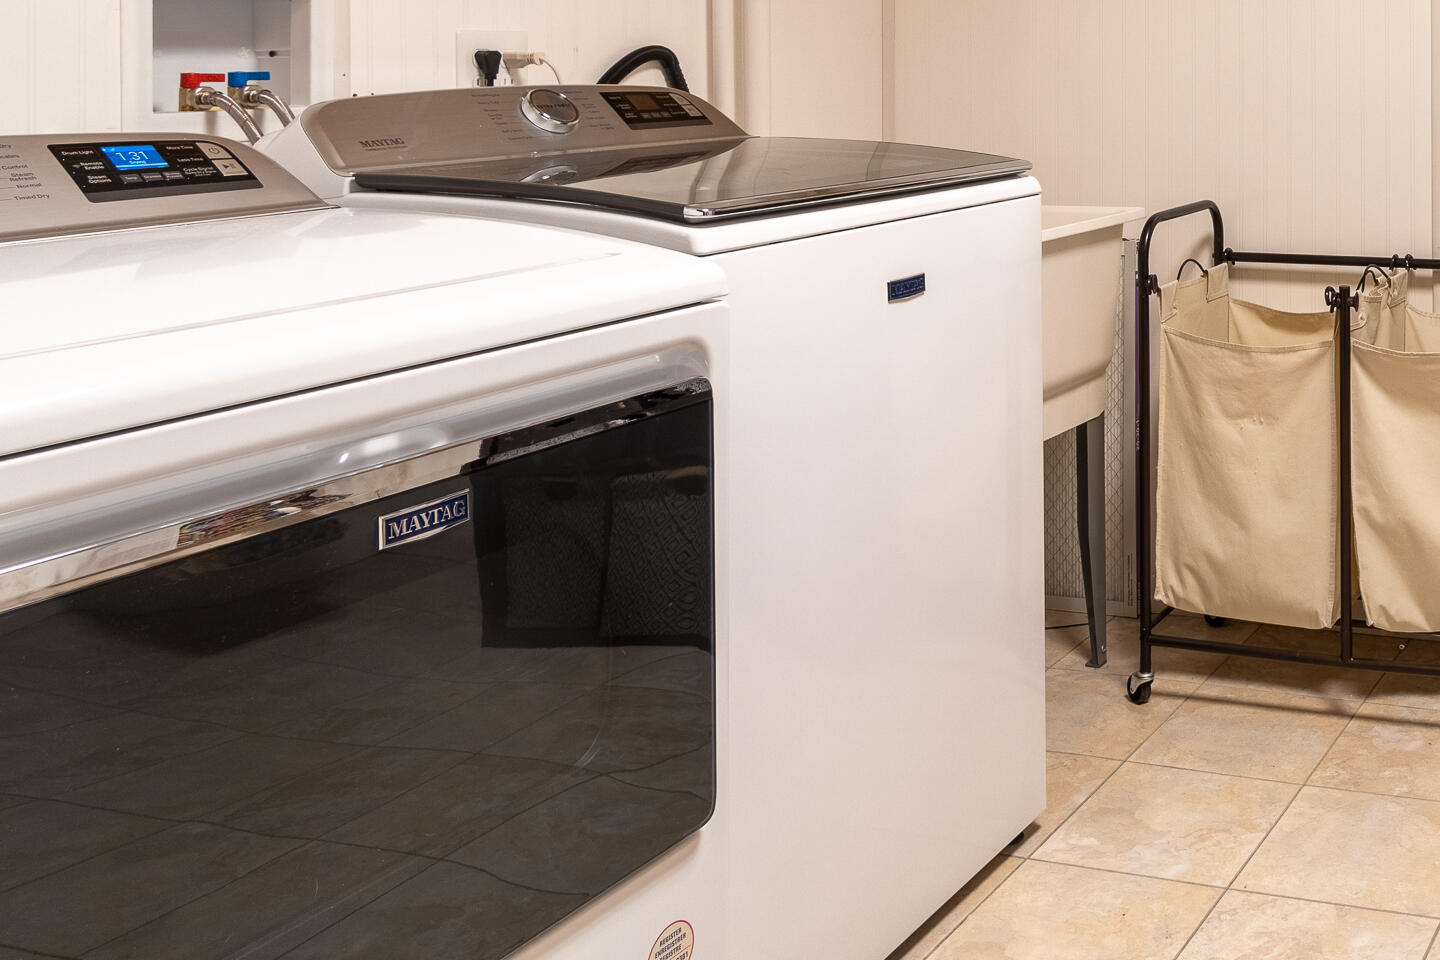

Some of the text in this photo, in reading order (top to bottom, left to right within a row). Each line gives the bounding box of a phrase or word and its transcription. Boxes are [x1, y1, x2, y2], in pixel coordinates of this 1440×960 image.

[360, 137, 405, 149] MAYTAG
[388, 500, 466, 540] MAYTAG
[660, 927, 682, 947] REGISTER
